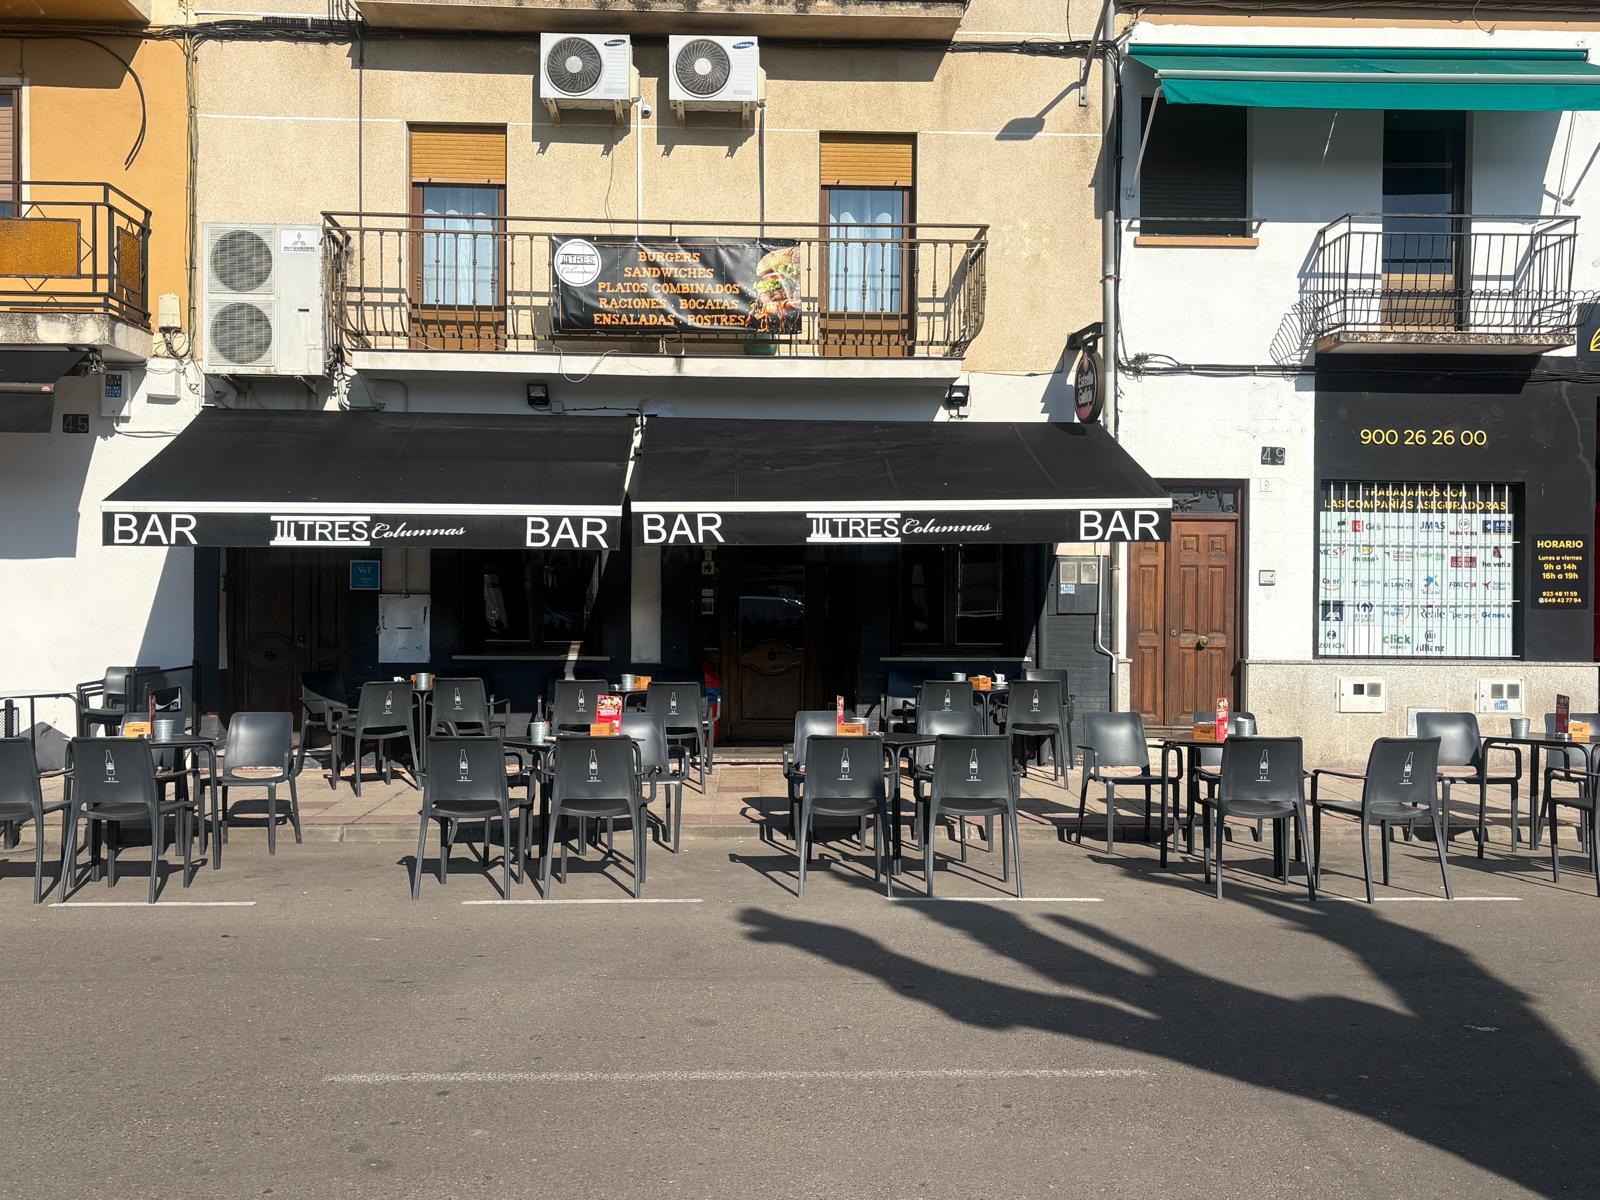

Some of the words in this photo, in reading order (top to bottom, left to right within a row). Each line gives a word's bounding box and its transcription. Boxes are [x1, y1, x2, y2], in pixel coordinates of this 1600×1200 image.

[638, 251, 700, 263] BURGERS
[624, 266, 714, 279] SANDWICHES
[597, 281, 648, 294] PLATOS
[652, 282, 740, 295] COMBINADOS
[599, 297, 667, 309] RACIONES
[679, 298, 740, 310] BOCATAS
[593, 313, 676, 326] ENSALADAS
[687, 314, 748, 327] POSTRES
[64, 415, 88, 432] 45
[1360, 429, 1399, 445] 900
[1403, 429, 1427, 445] 26
[1432, 429, 1456, 445] 26
[1460, 430, 1487, 446] 00
[1262, 447, 1285, 464] 49
[1363, 487, 1440, 497] TRABAJAMOS
[1324, 500, 1345, 509] LAS
[1347, 498, 1414, 509] COMPAÑÍAS
[1416, 500, 1506, 510] ASEGURADORAS
[113, 513, 199, 545] BAR
[297, 520, 369, 541] TRES
[371, 522, 467, 540] Columnas
[525, 516, 609, 548] BAR
[642, 512, 725, 543] BAR
[832, 518, 900, 538] TRES
[901, 517, 992, 535] Columnas
[1079, 510, 1161, 541] BAR
[1537, 540, 1584, 548] HORARIO
[1543, 563, 1554, 571] 9h
[1481, 611, 1511, 619] Géness
[1382, 634, 1411, 645] click
